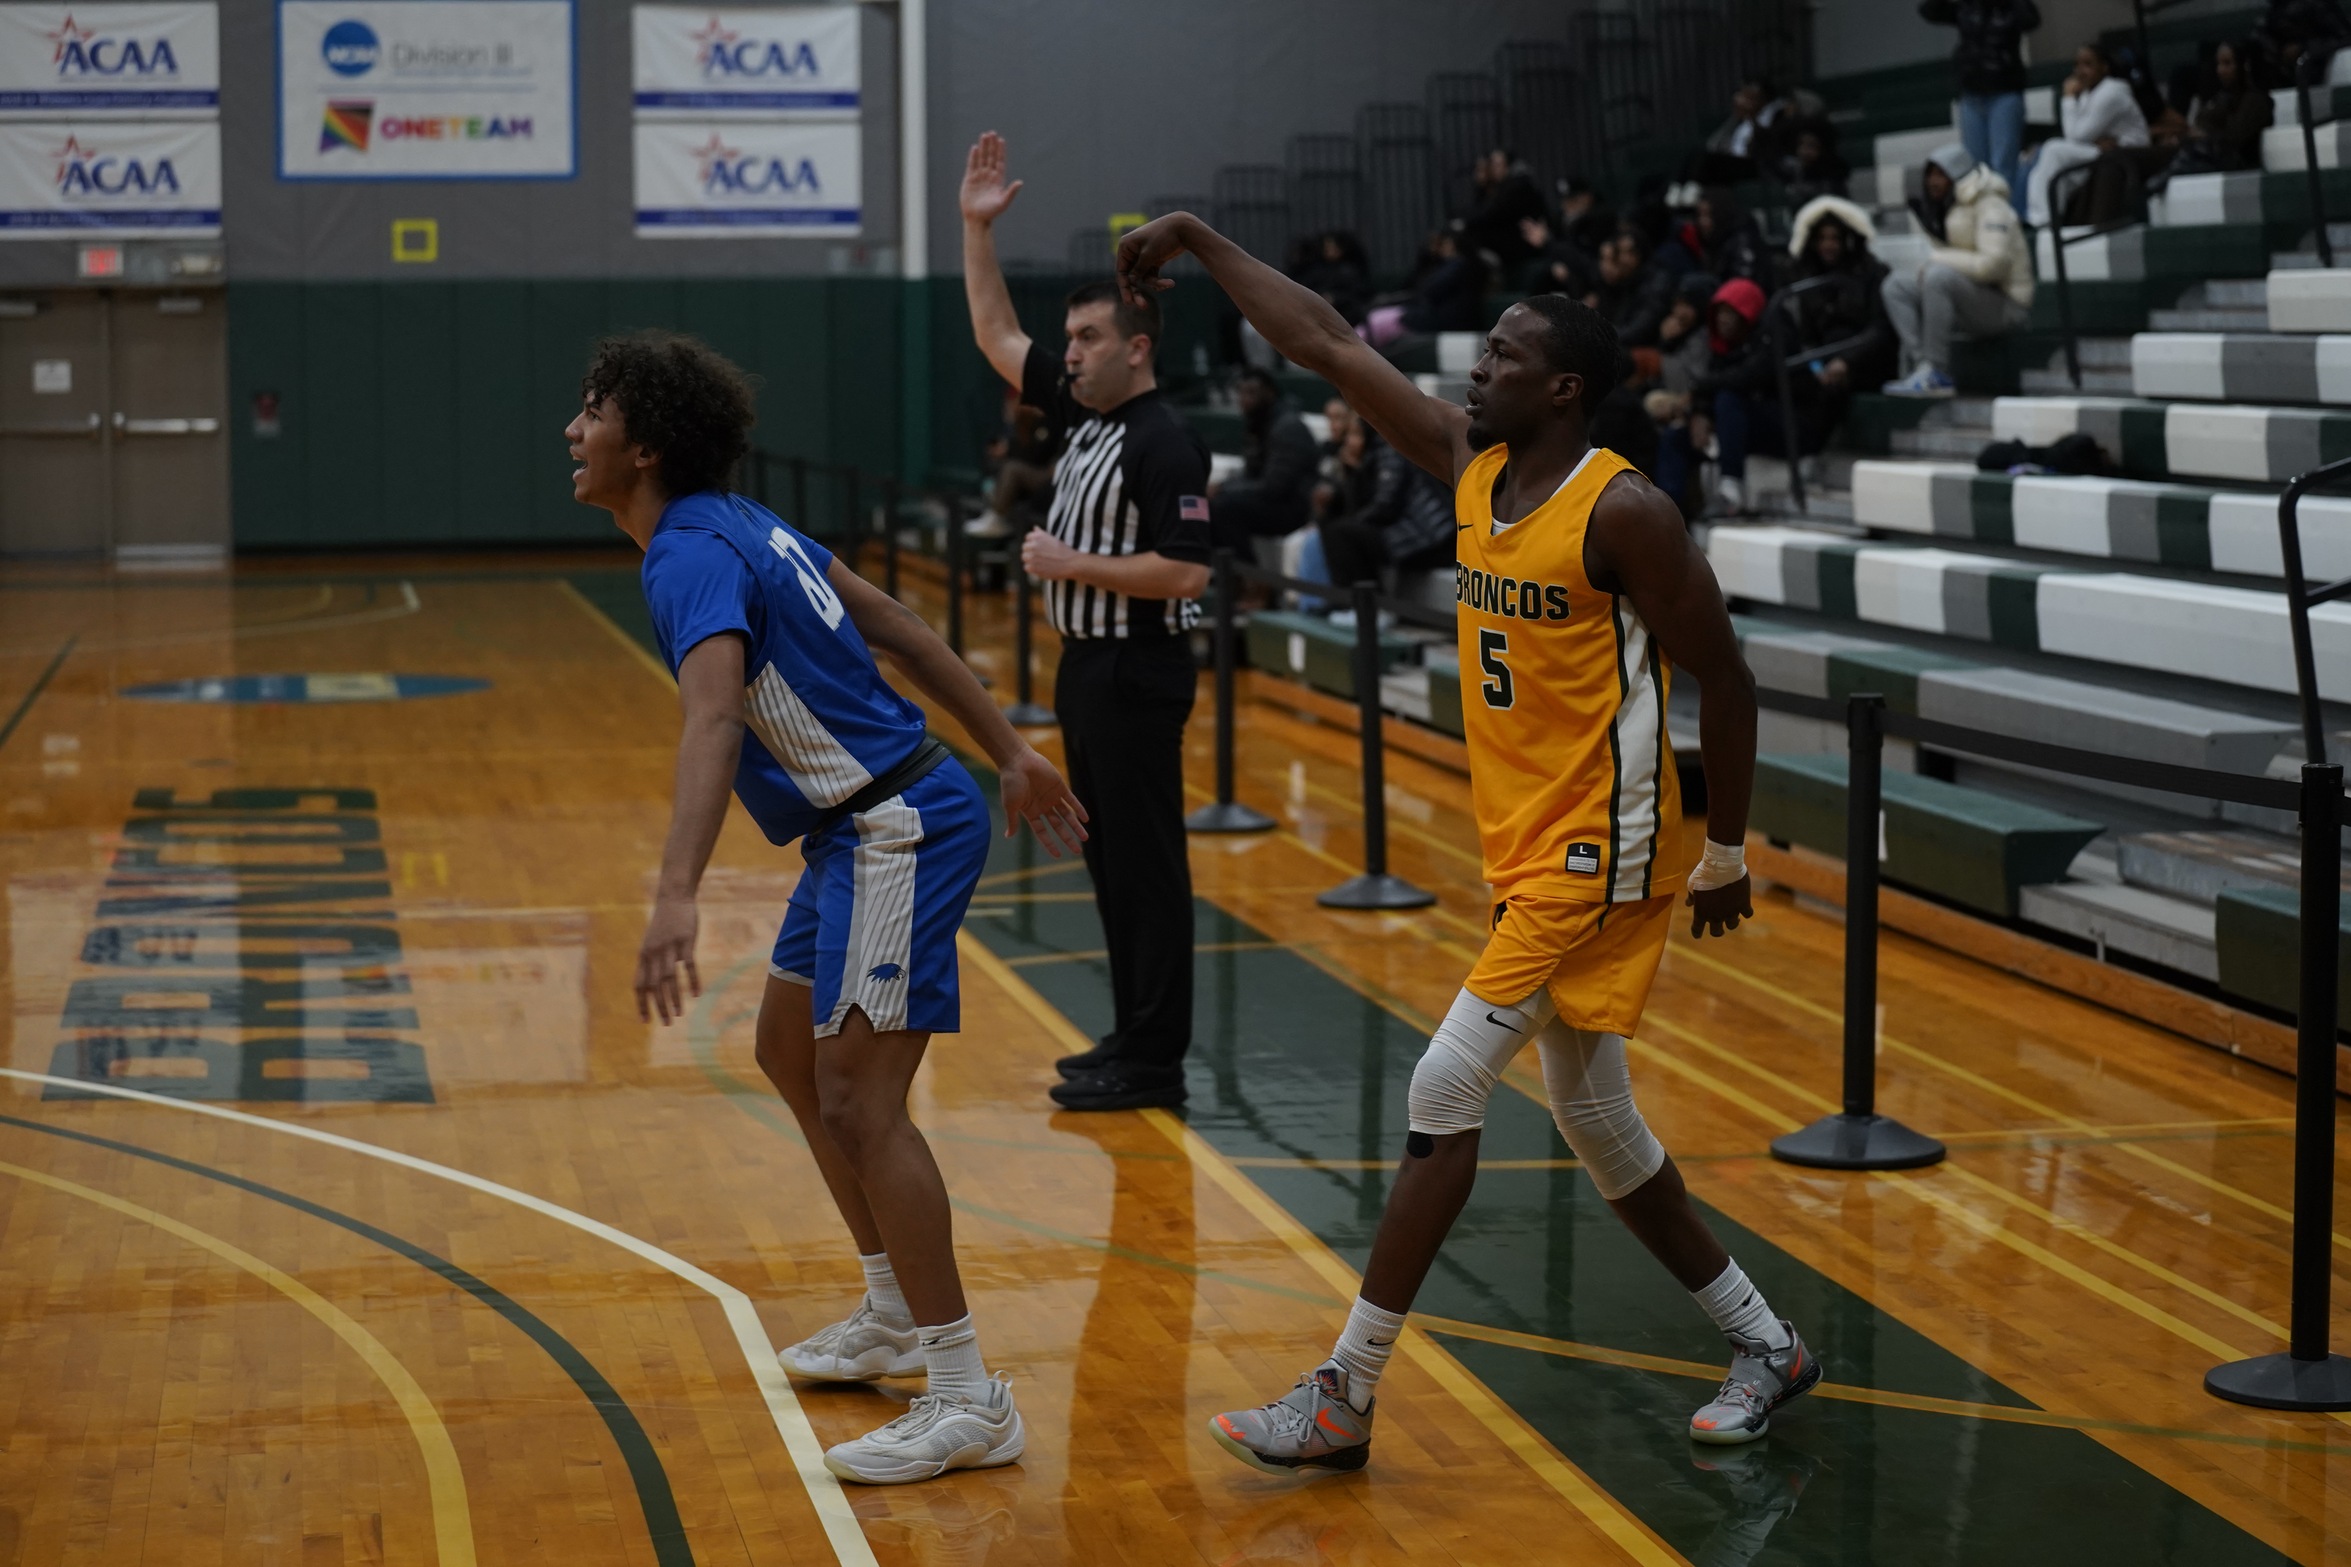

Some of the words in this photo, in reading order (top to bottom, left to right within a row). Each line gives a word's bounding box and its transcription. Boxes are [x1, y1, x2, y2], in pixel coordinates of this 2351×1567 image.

[59, 38, 178, 75] ACAA
[392, 42, 487, 67] Division
[705, 40, 819, 77] ACAA
[379, 116, 534, 140] ONETEAM
[62, 158, 180, 195] ACAA
[706, 158, 820, 194] ACAA
[1456, 560, 1571, 621] BRONCOS
[1479, 626, 1516, 711] 5
[1579, 845, 1588, 855] L
